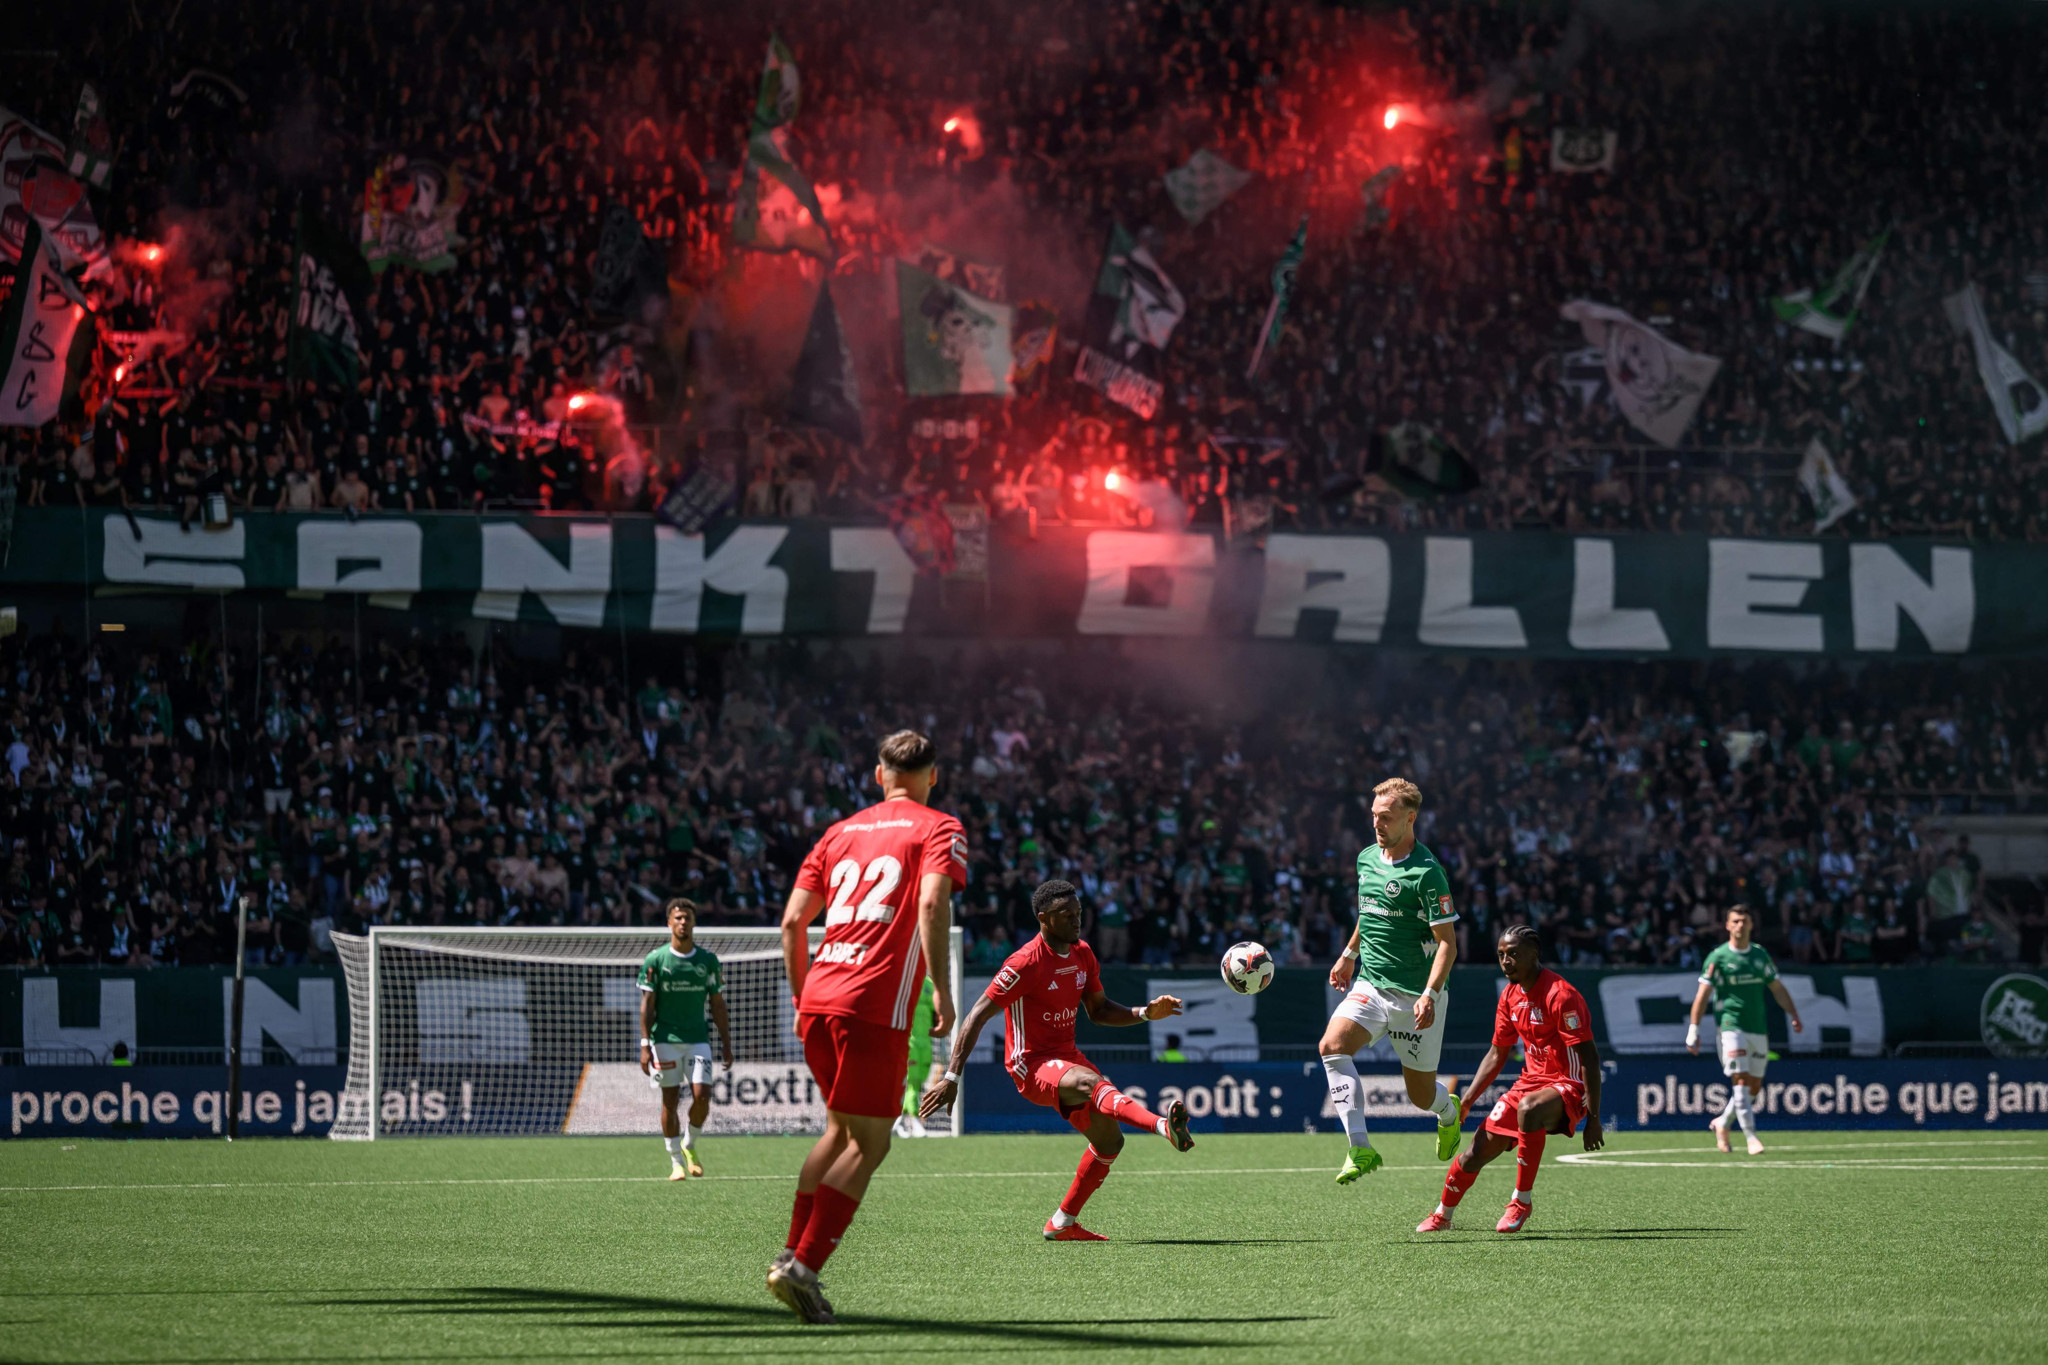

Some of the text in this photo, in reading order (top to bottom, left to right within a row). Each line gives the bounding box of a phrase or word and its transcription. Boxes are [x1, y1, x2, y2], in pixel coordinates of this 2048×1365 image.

[103, 514, 917, 634] SANKT
[1079, 530, 1974, 653] GALLEN
[826, 855, 901, 928] 22
[11, 1081, 181, 1135] proche
[192, 1090, 282, 1134] que
[1157, 1074, 1260, 1118] août
[1637, 1074, 1730, 1126] plus
[1898, 1081, 1979, 1124] que
[1984, 1071, 2048, 1123] jam
